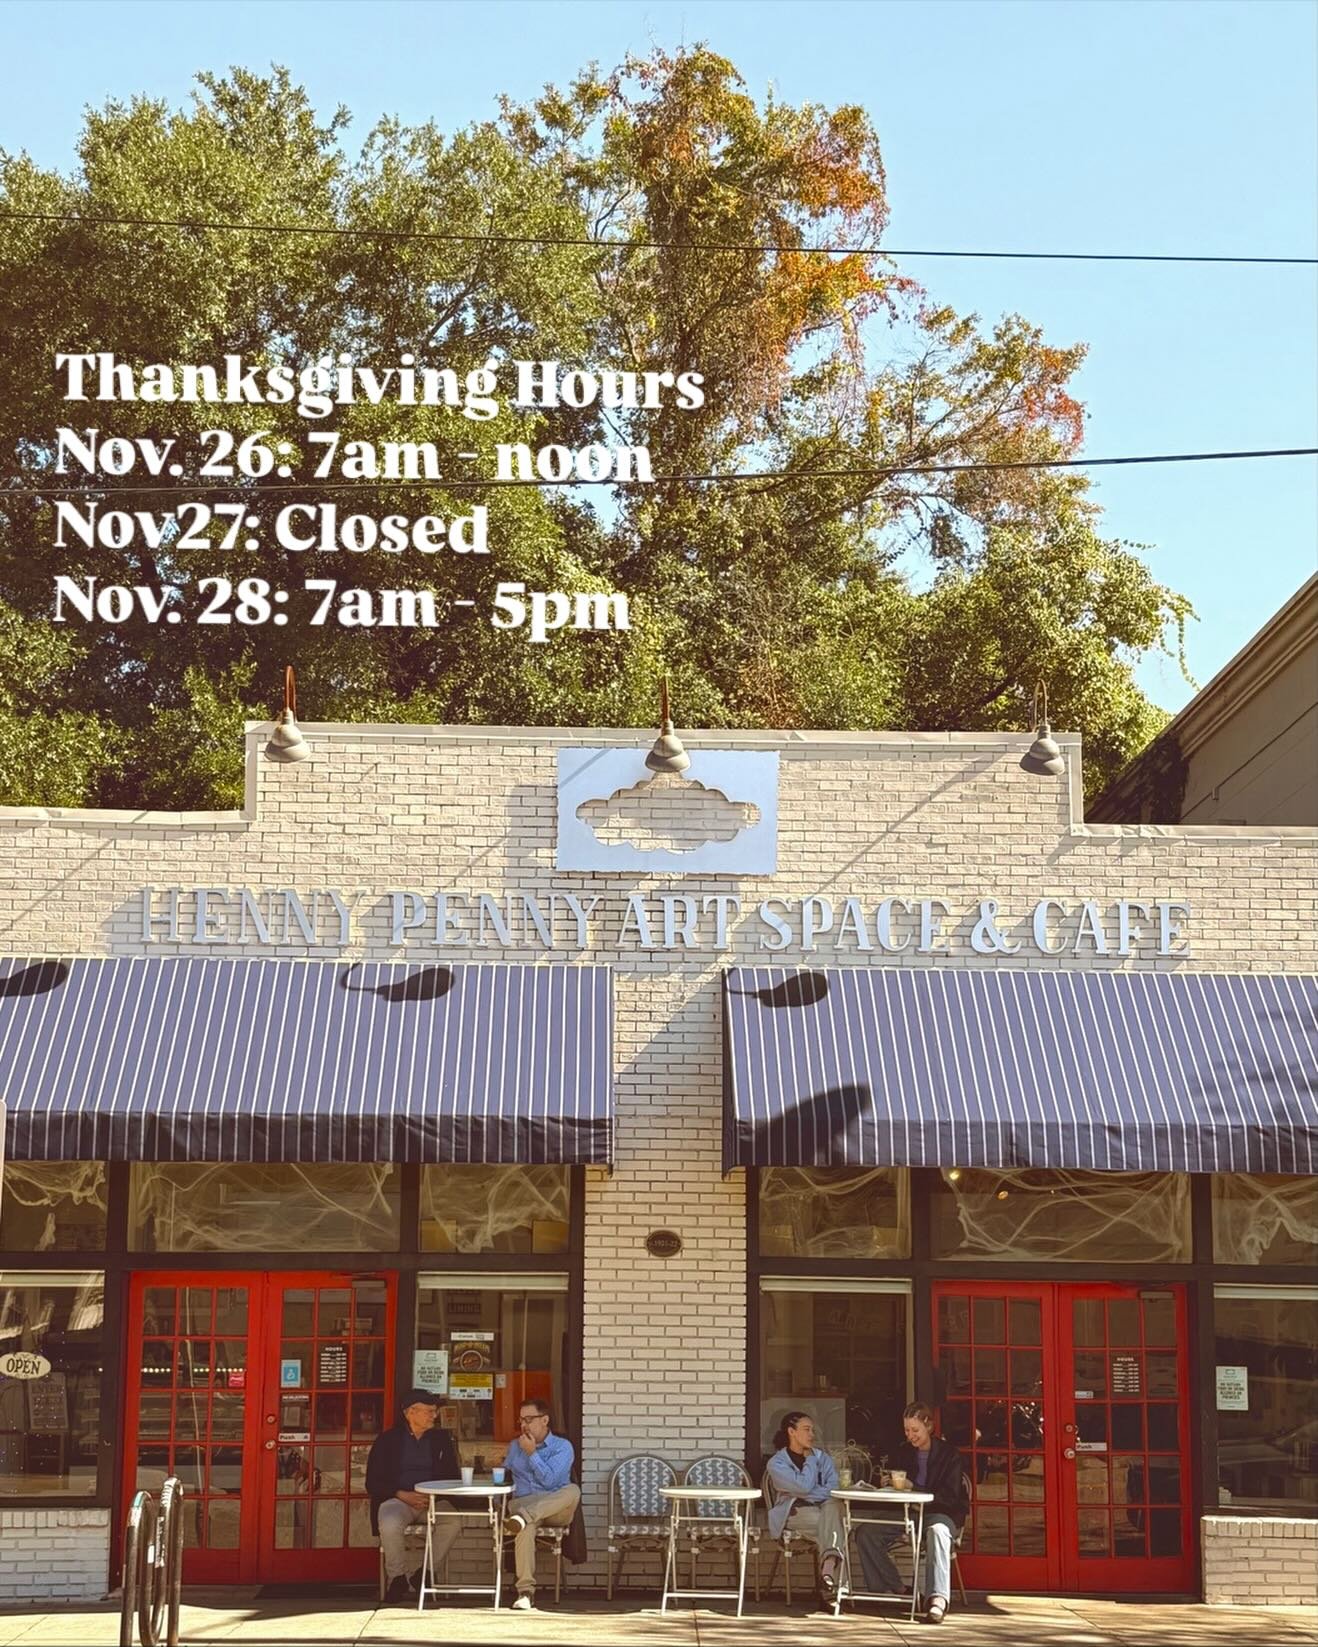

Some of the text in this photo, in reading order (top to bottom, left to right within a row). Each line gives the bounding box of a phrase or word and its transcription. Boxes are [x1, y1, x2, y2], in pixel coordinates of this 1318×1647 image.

[140, 886, 1191, 958] HENNY PENNY ART SPACE & CAFE
[6, 1358, 41, 1375] OPEN
